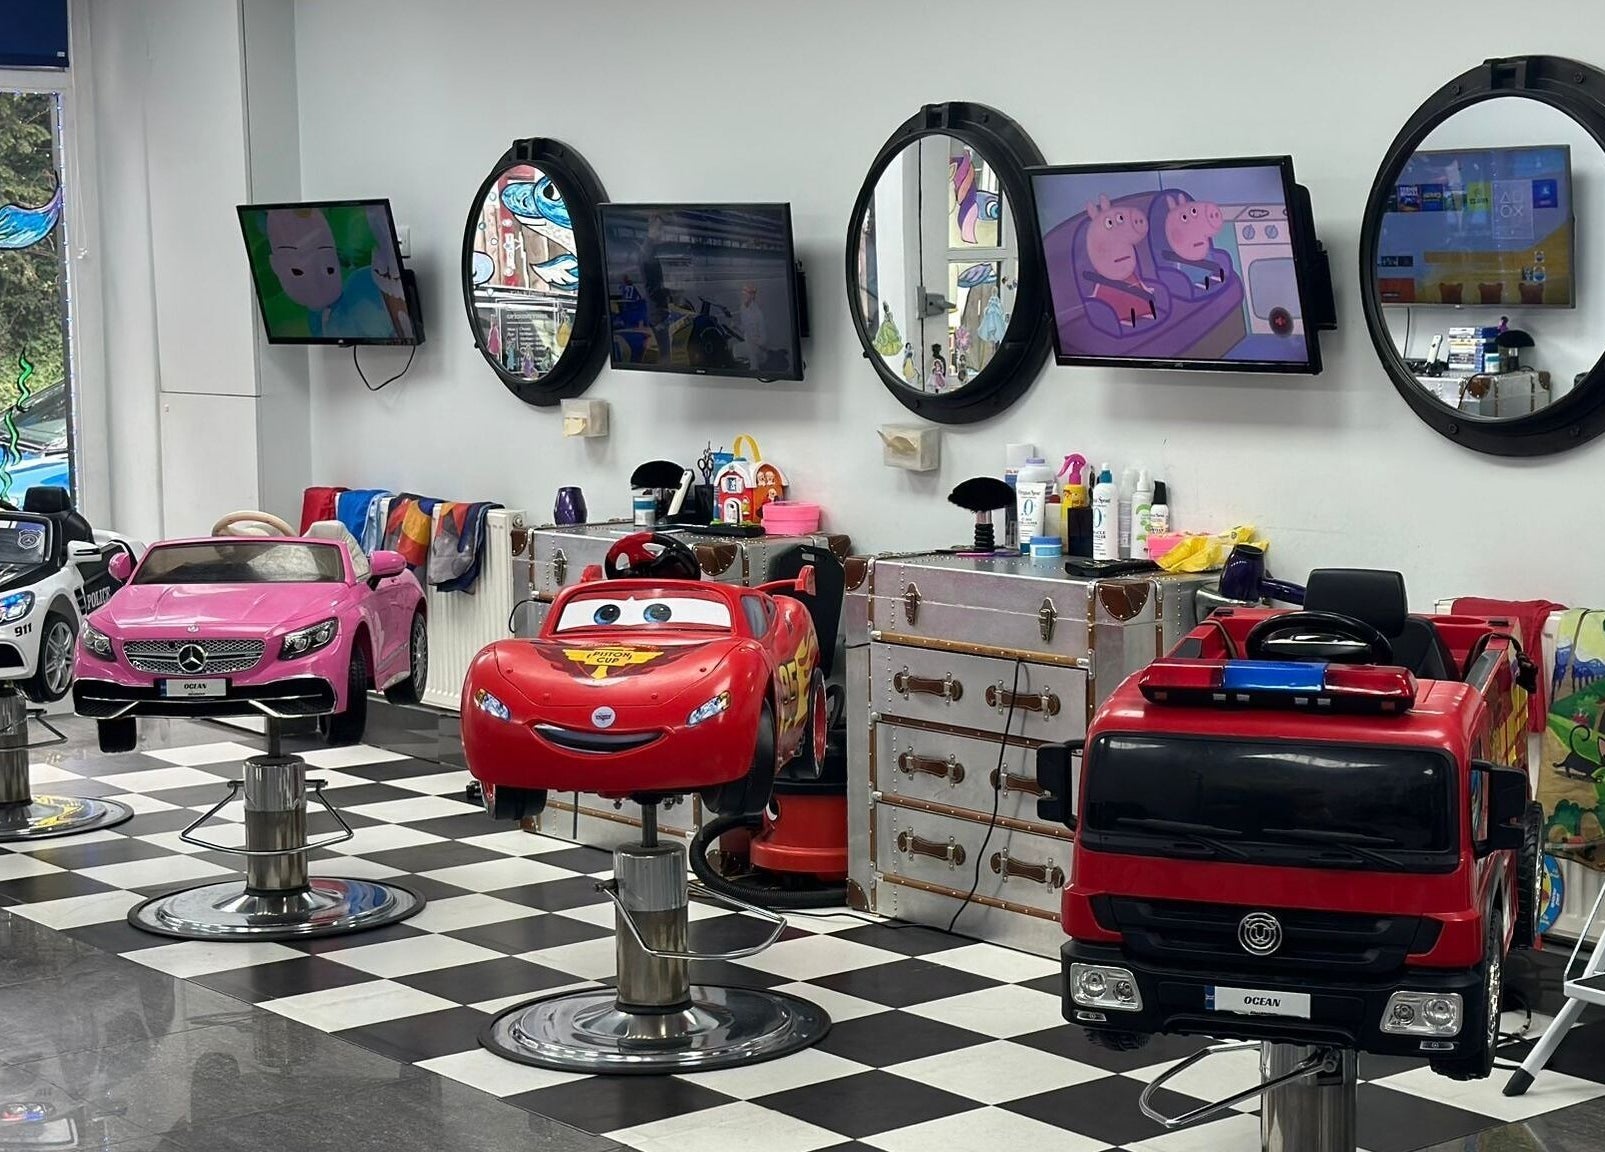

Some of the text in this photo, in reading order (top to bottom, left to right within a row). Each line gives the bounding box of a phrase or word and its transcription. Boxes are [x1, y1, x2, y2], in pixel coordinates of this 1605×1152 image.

[87, 586, 111, 610] POLICE
[14, 622, 32, 637] 911
[1243, 995, 1281, 1007] OCEAN
